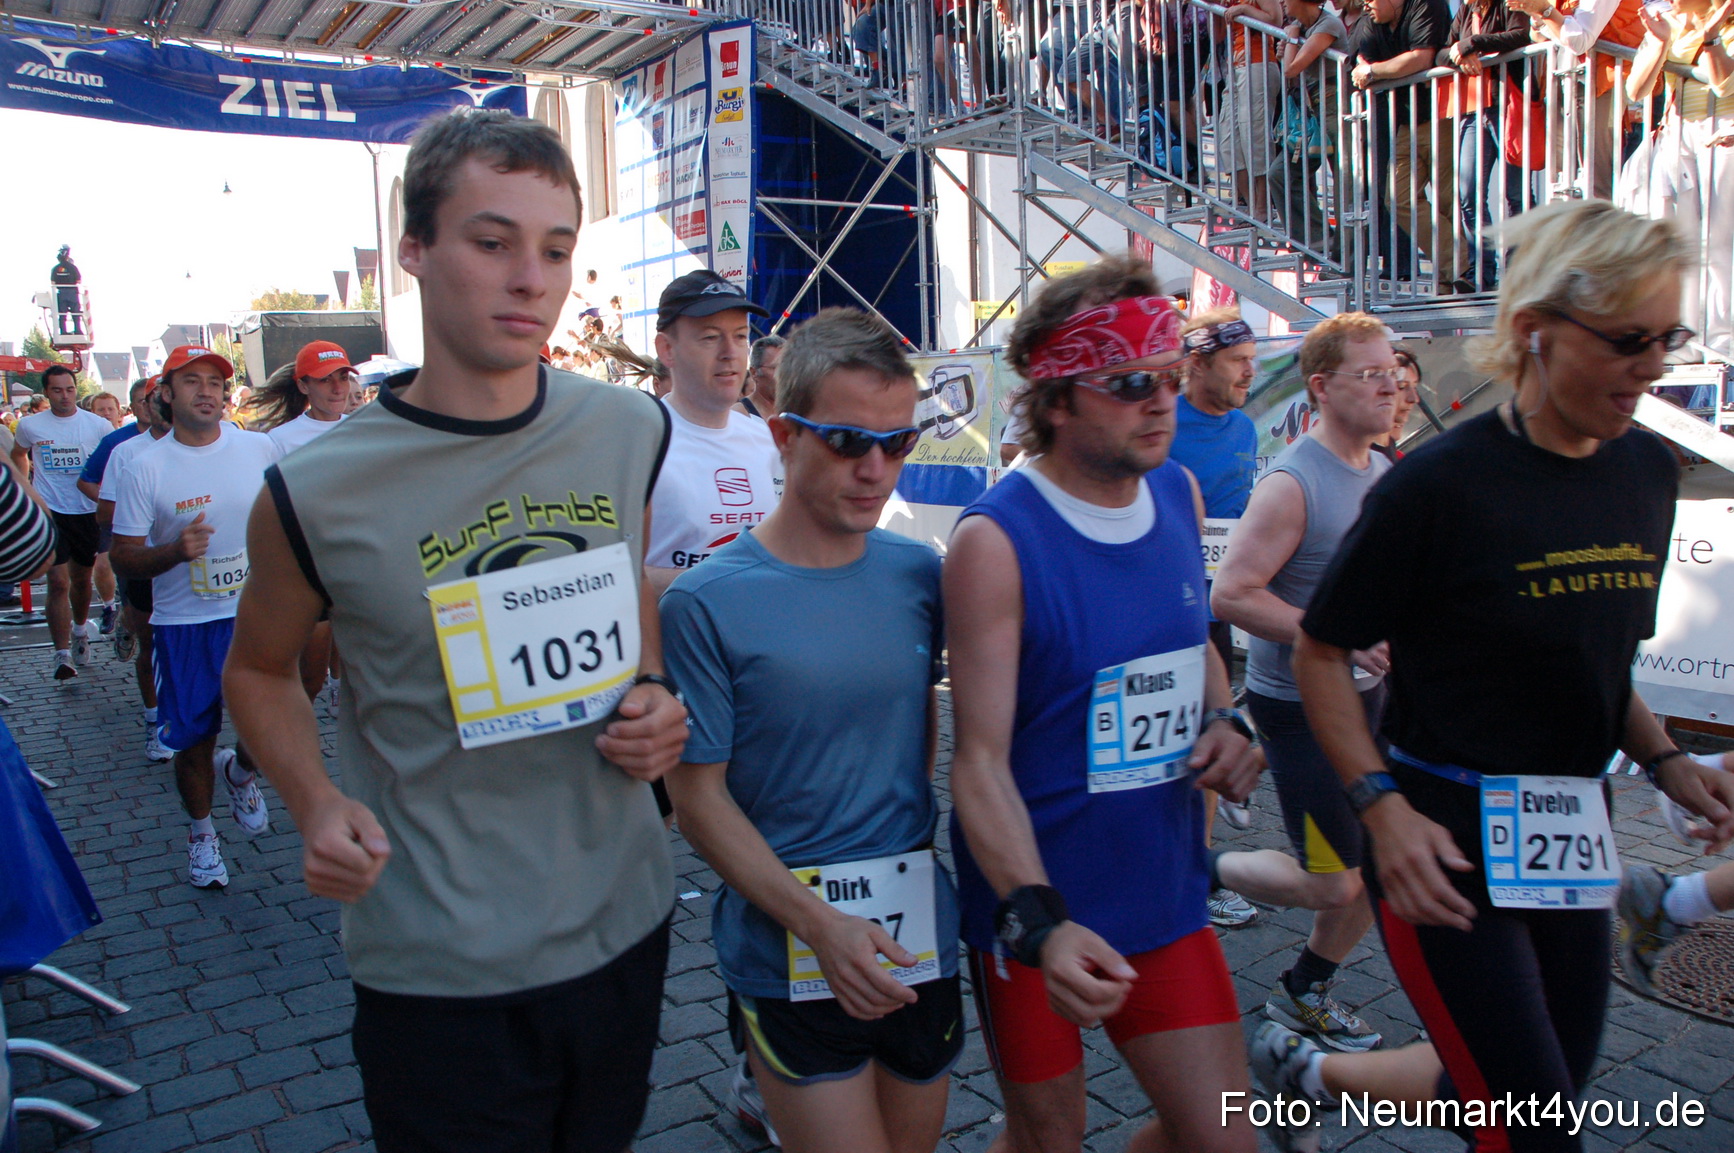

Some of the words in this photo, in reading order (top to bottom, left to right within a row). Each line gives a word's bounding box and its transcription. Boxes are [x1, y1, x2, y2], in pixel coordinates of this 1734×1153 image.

[7, 83, 114, 105] www.mizunoeurope.com
[218, 74, 357, 123] ZIEL
[53, 456, 81, 467] 2193
[916, 442, 938, 462] Der
[175, 494, 212, 511] MERZ
[709, 512, 766, 525] SEAT
[211, 552, 243, 565] Richard
[502, 570, 616, 611] Sebastian
[510, 620, 626, 688] 1031
[1124, 669, 1176, 698] Klaus
[1098, 712, 1113, 732] B
[1130, 700, 1199, 752] 2741
[1521, 790, 1582, 816] Evelyn
[1491, 824, 1509, 845] D
[1525, 833, 1609, 872] 2791
[826, 875, 874, 902] Dirk
